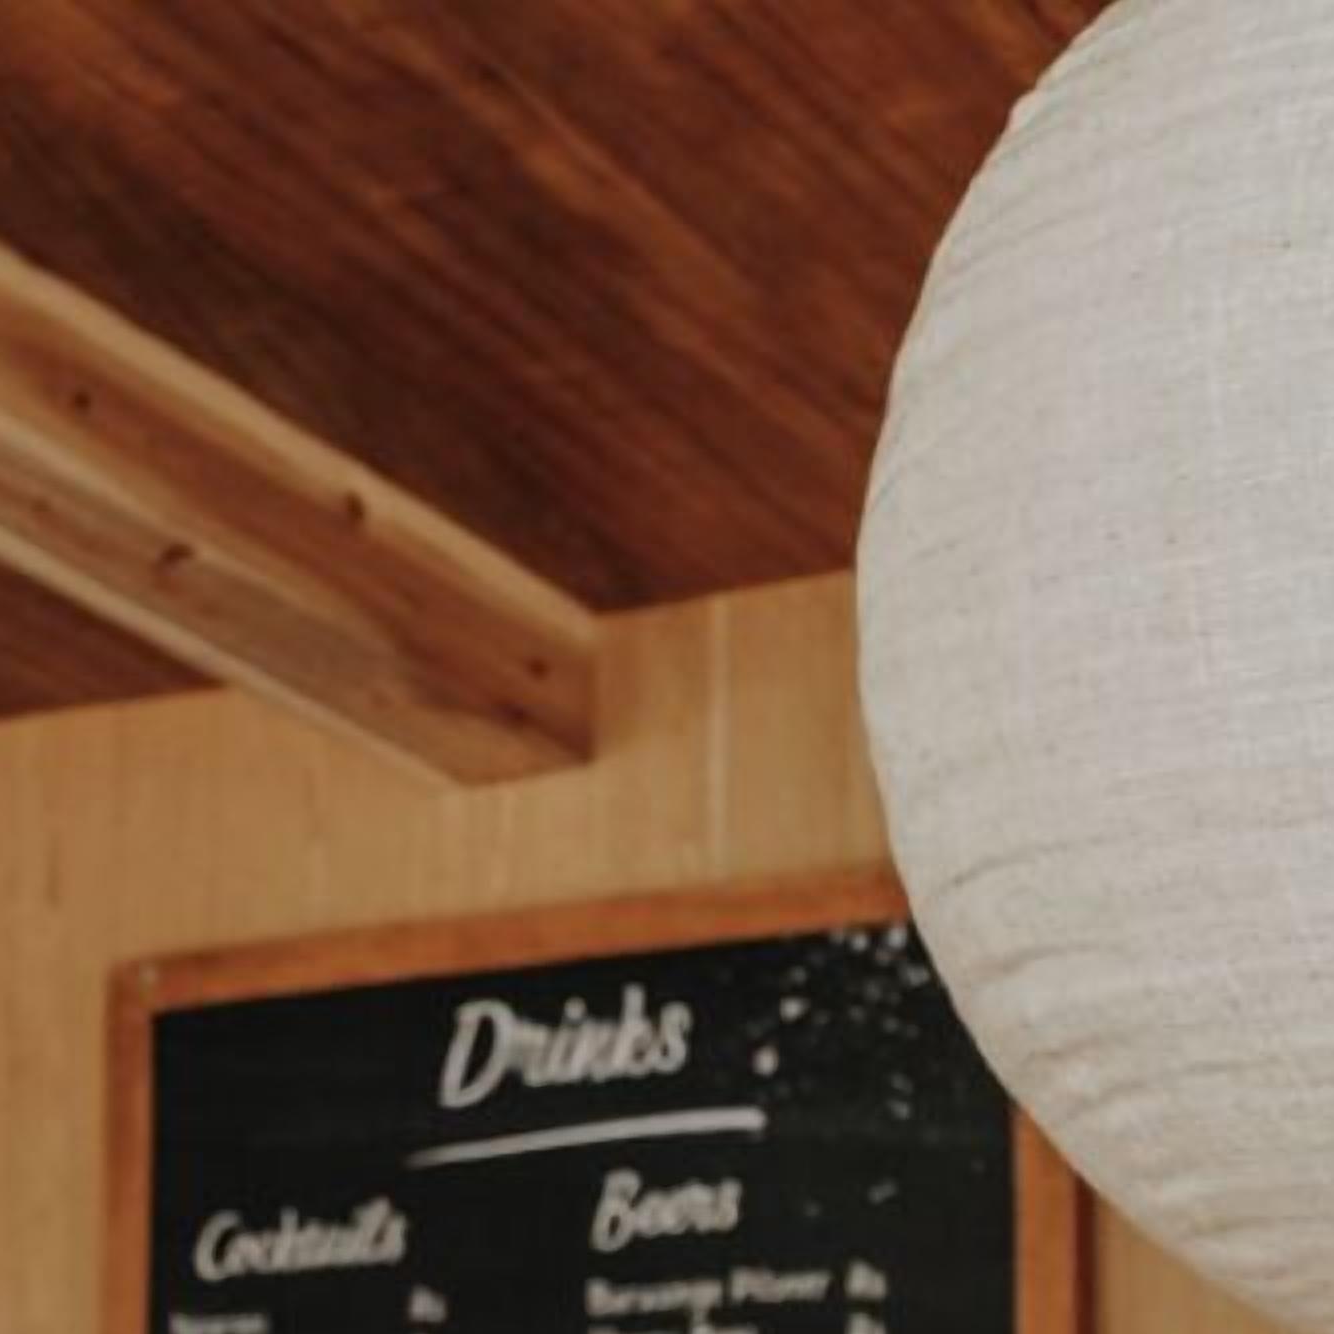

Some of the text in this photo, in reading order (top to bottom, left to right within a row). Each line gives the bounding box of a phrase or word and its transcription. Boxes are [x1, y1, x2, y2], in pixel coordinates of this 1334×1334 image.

[440, 985, 691, 1107] Drinks
[195, 1198, 407, 1280] Cocktails
[593, 1171, 741, 1250] Beers
